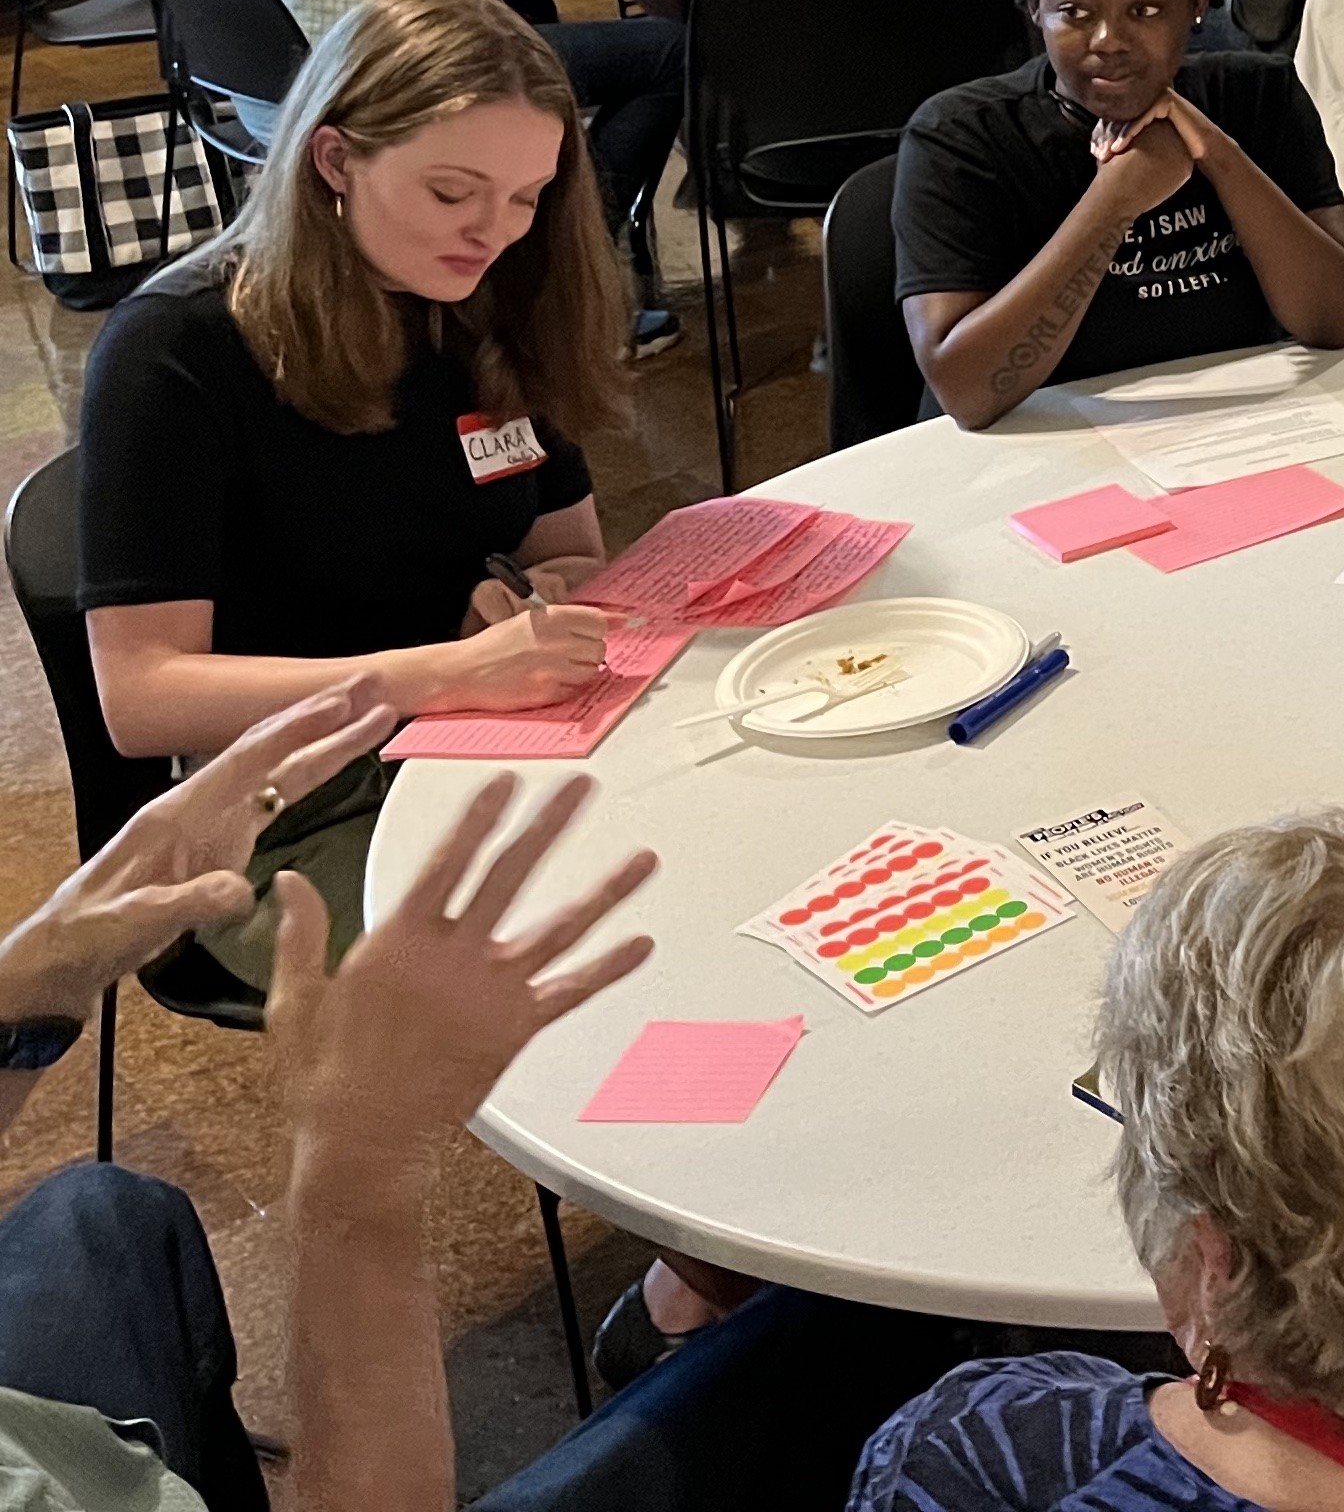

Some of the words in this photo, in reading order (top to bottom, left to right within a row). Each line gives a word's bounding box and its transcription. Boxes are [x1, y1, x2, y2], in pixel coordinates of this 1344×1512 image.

[1123, 227, 1143, 244] E,
[1150, 219, 1156, 239] I
[1158, 204, 1206, 235] SAW
[1108, 250, 1144, 277] ad
[1137, 285, 1163, 300] SO
[1168, 280, 1174, 296] I
[468, 426, 527, 461] CLARA
[1040, 851, 1052, 862] IF
[1055, 841, 1080, 857] YOU
[1055, 853, 1090, 869] BLACK
[1091, 841, 1121, 857] LIVES
[1122, 826, 1163, 845] MATTER
[1073, 851, 1125, 873] WOMEN'S
[1125, 836, 1164, 856] RIGHTS
[1074, 869, 1097, 882] ARE
[1099, 855, 1136, 874] HUMAN
[1137, 840, 1175, 860] RIGHTS
[1095, 874, 1112, 886] NO
[1113, 860, 1152, 880] HUMAN
[1153, 855, 1166, 865] IS
[1122, 895, 1144, 908] LO
